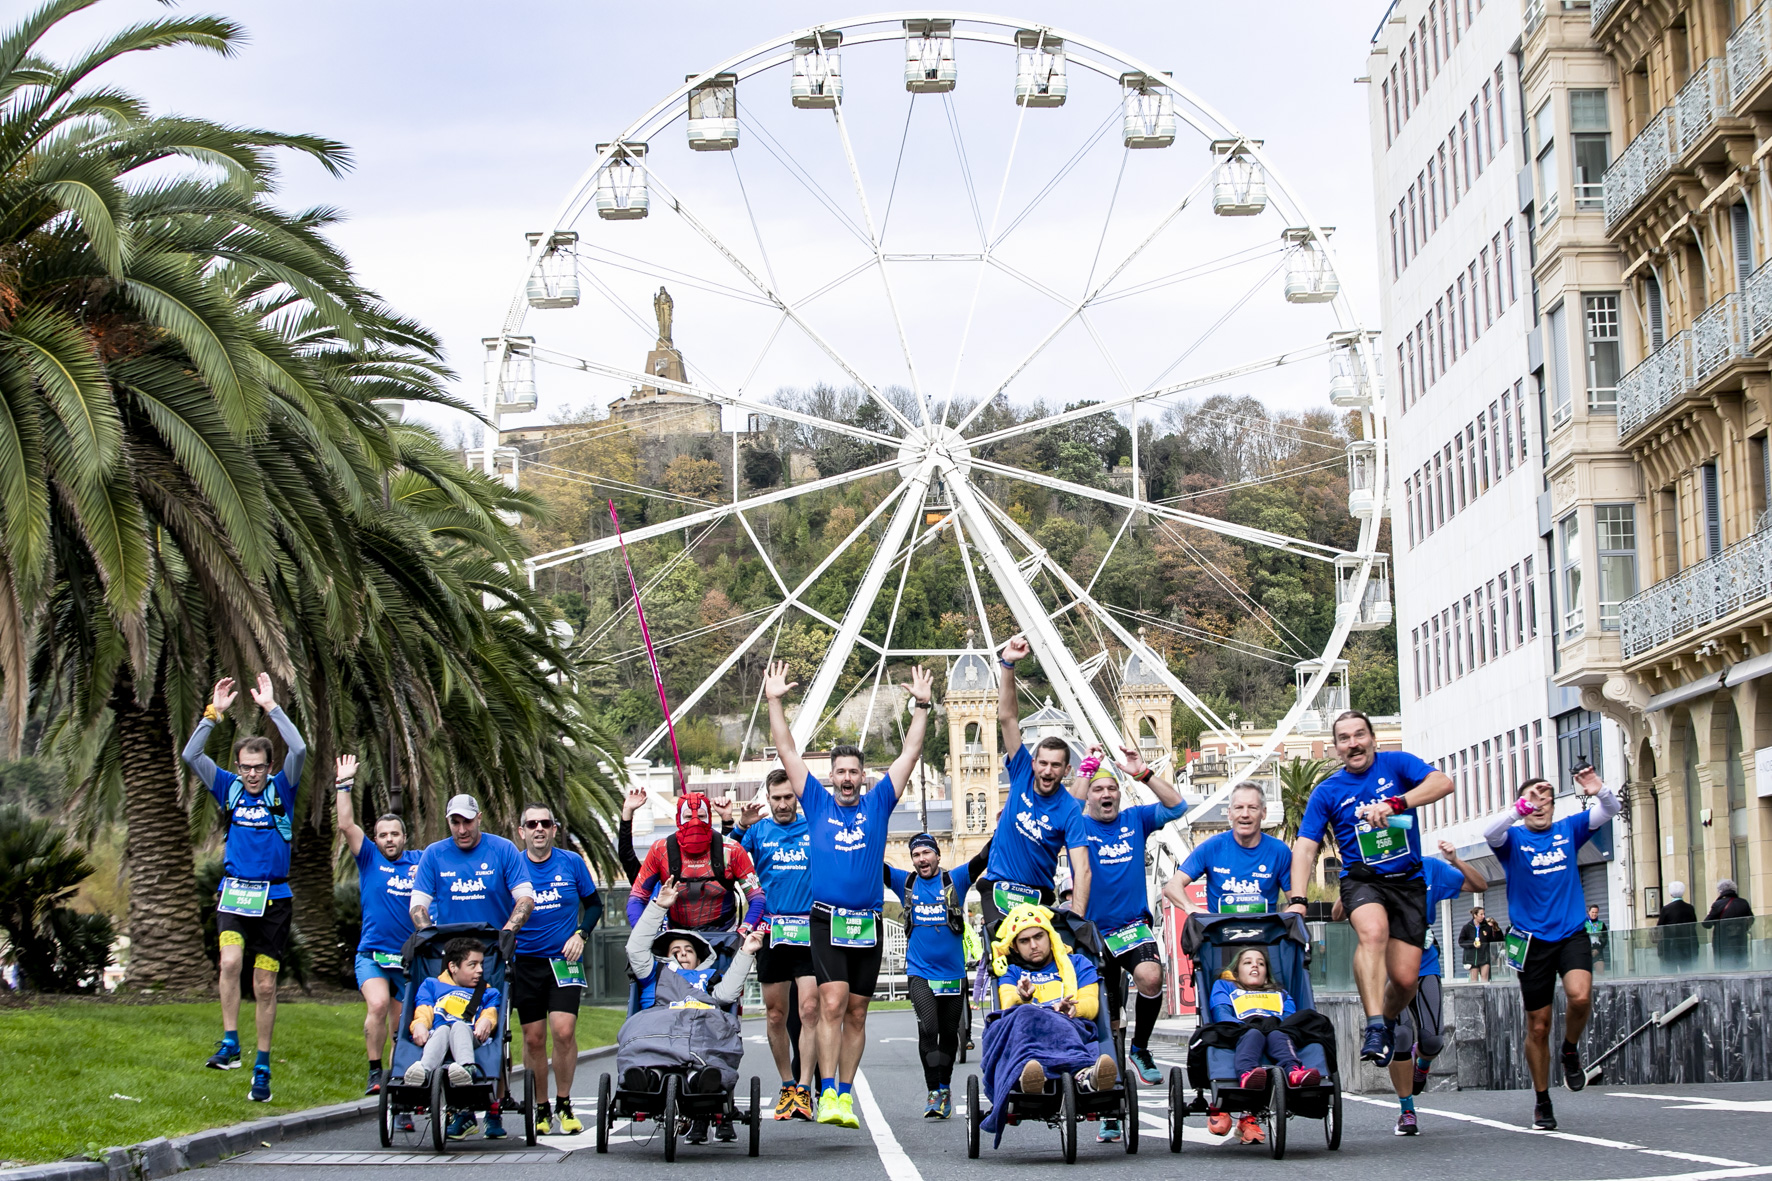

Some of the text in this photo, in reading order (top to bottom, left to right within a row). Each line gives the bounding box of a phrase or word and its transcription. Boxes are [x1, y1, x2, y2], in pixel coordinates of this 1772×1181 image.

[1375, 780, 1394, 794] ZURICH
[1118, 829, 1135, 840] ZURICH
[1011, 885, 1034, 895] ZURICH
